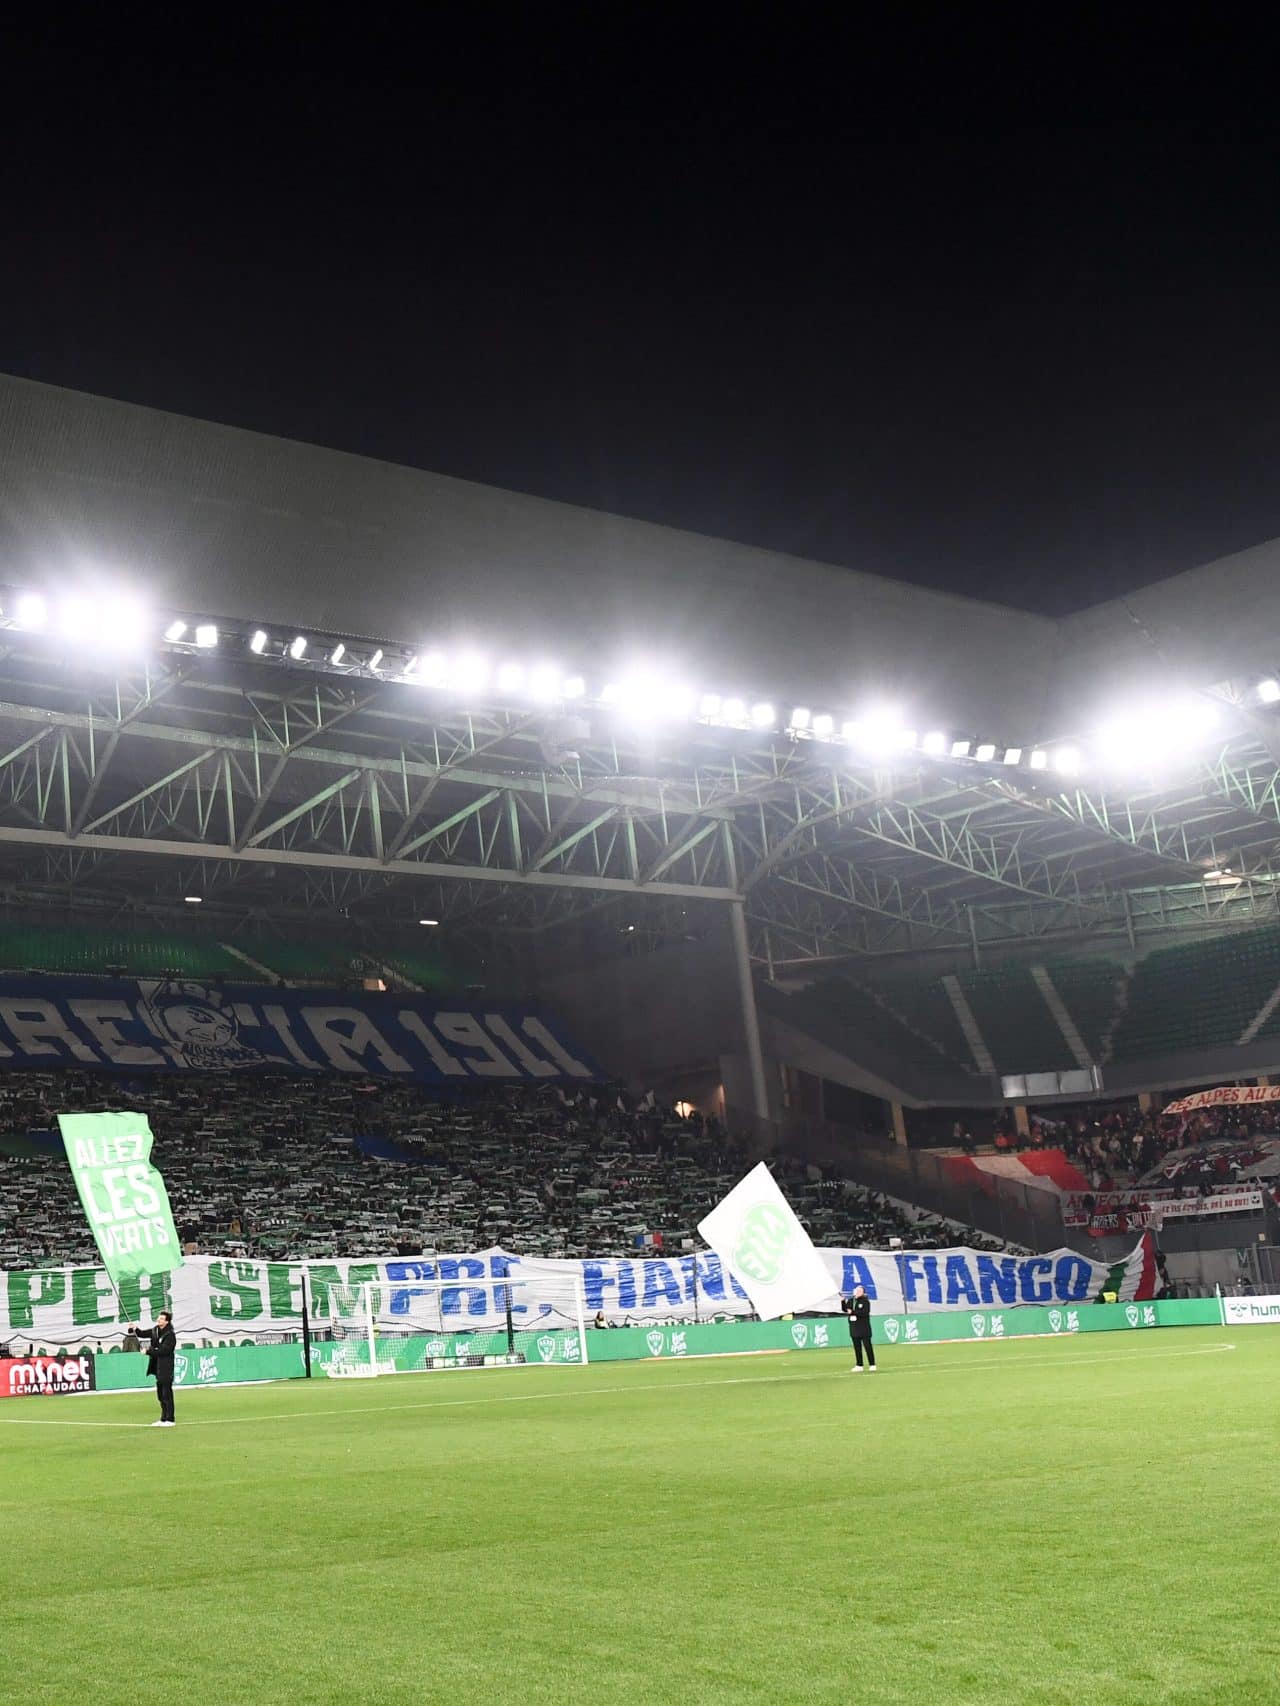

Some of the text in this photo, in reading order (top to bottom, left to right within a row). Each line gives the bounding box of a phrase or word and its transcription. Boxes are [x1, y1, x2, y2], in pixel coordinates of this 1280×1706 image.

[397, 1010, 593, 1077] 1911
[1196, 1089, 1240, 1106] ALPES
[1244, 1087, 1266, 1101] AU
[74, 1134, 145, 1169] ALLEZ
[80, 1163, 161, 1224] LES
[97, 1216, 170, 1257] VERTS
[7, 1270, 172, 1329] PER
[841, 1255, 877, 1300] A
[895, 1253, 1093, 1305] FIANCO
[9, 1381, 90, 1394] ECHAFAUDAGE
